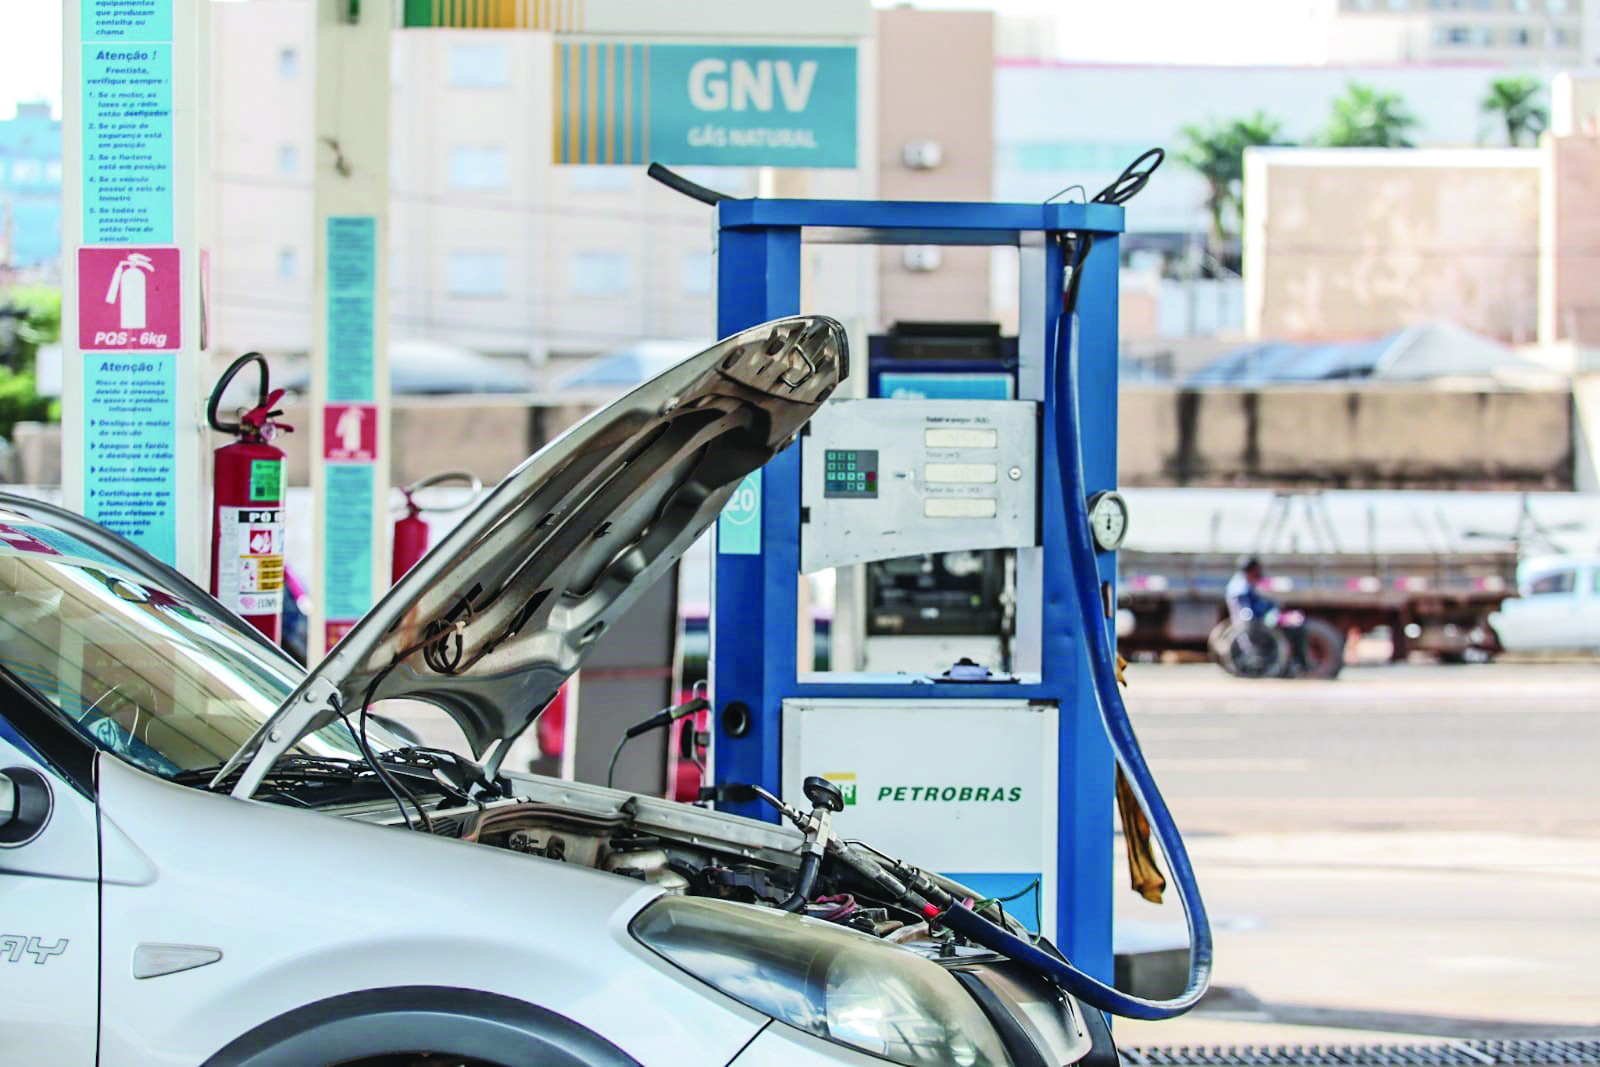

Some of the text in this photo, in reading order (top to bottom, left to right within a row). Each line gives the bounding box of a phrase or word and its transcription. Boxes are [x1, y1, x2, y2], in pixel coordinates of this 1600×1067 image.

[96, 50, 148, 62] Atenção
[688, 58, 818, 112] GNV
[688, 124, 818, 148] GÁS NATURAL
[94, 331, 128, 345] PQS
[139, 331, 168, 348] 6kg
[100, 361, 154, 374] Atenção
[726, 487, 755, 512] 20
[877, 786, 1023, 802] PETROBRAS
